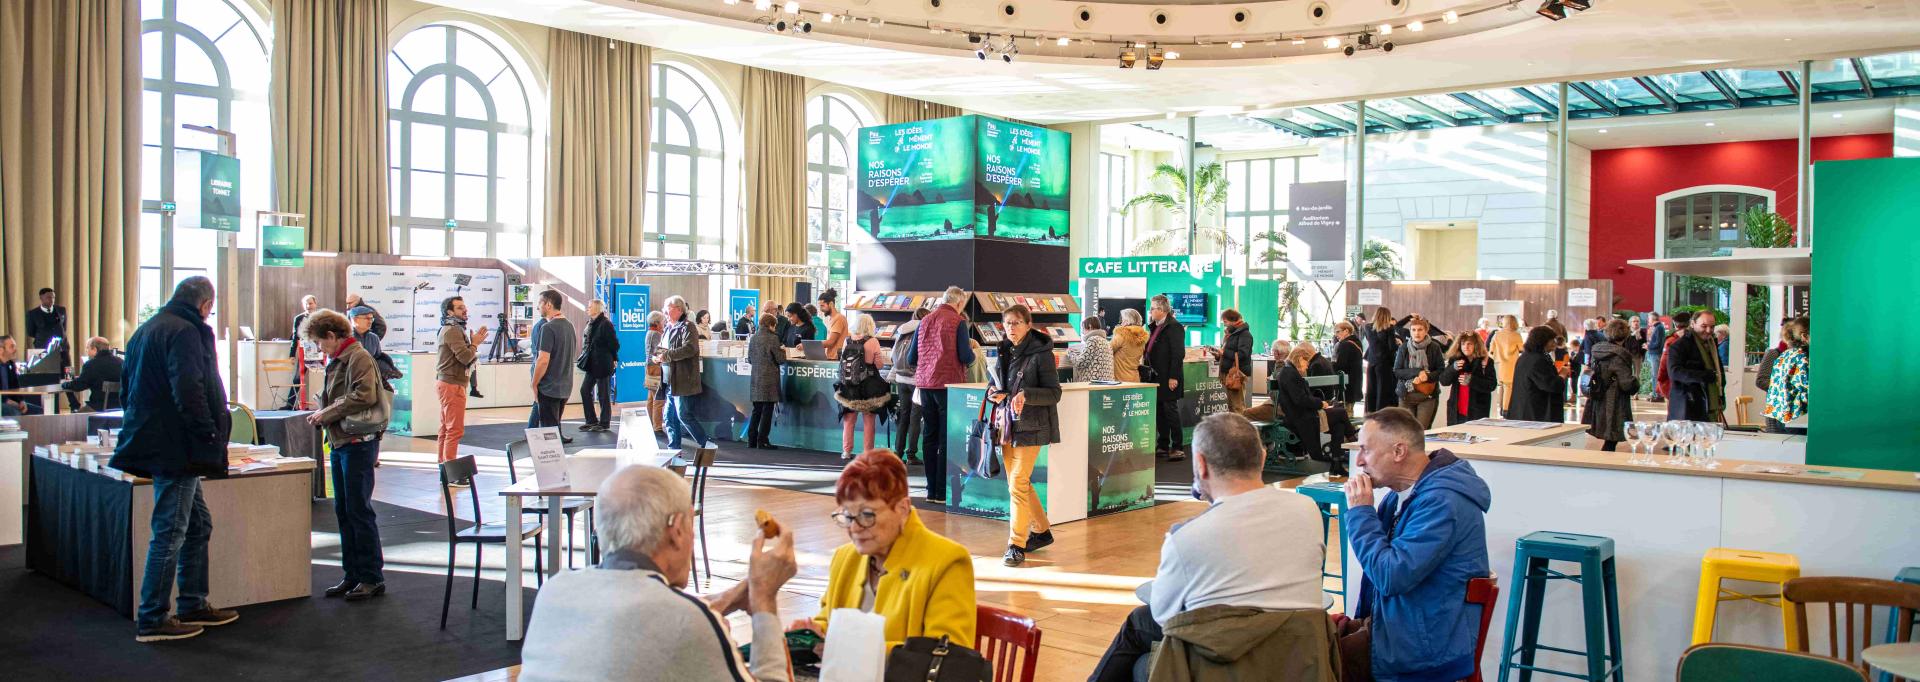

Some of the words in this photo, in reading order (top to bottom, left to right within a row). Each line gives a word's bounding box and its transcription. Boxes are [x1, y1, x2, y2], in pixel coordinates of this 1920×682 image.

[894, 128, 905, 136] LES
[906, 126, 923, 135] IDÉES
[903, 144, 911, 152] LE
[911, 142, 933, 150] MONDE
[1023, 147, 1041, 155] MONDE
[986, 153, 1001, 164] NOS
[868, 160, 885, 169] NOS
[986, 163, 1016, 176] RAISONS
[868, 168, 902, 178] RAISONS
[1085, 261, 1122, 274] CAFE
[1127, 260, 1214, 273] LITTERARE
[621, 309, 645, 323] bleu
[727, 363, 738, 373] NO
[1195, 381, 1206, 391] LES
[1209, 391, 1228, 401] MÈNEN
[1203, 405, 1211, 414] LE
[1211, 403, 1228, 413] MOND
[1102, 425, 1115, 435] NOS
[1102, 433, 1128, 444] RAISONS
